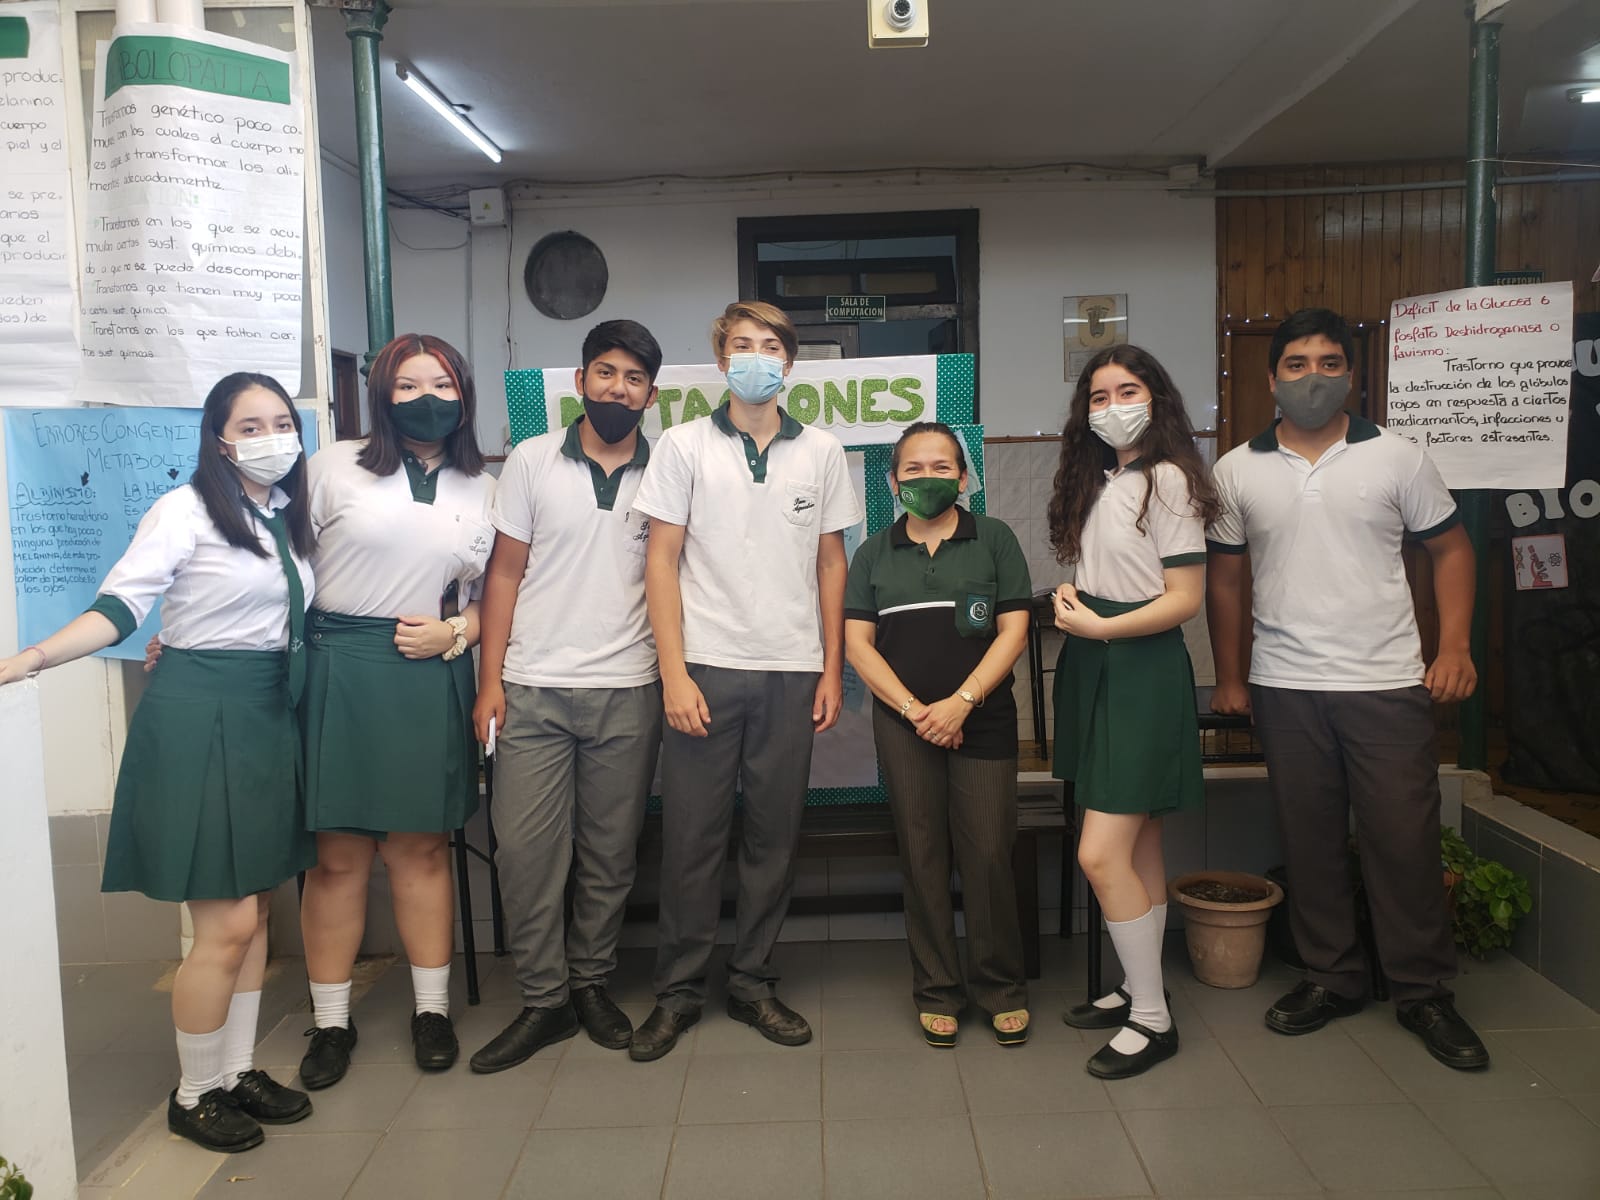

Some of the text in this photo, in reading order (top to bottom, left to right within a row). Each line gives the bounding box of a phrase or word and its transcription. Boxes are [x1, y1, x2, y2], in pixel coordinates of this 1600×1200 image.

[151, 103, 224, 124] genético
[234, 117, 272, 134] poco
[0, 121, 47, 134] cuerpo
[6, 139, 62, 153] piel y el
[155, 127, 200, 141] cuales
[210, 132, 222, 145] el
[231, 139, 283, 155] cuerpo
[133, 147, 229, 168] transformar
[240, 158, 264, 173] los
[8, 190, 24, 200] se
[146, 217, 163, 227] en
[171, 216, 193, 230] los
[207, 223, 235, 239] que
[243, 225, 260, 234] se
[1, 229, 50, 247] que el
[153, 262, 194, 275] puede
[146, 283, 167, 297] que
[176, 281, 222, 297] tienen
[232, 289, 262, 302] muy
[841, 297, 870, 307] SALA DE
[1445, 299, 1461, 312] de
[1466, 299, 1478, 311] la
[1480, 296, 1532, 309] Glucosa
[1540, 295, 1551, 305] 6
[30, 311, 47, 323] de
[828, 307, 883, 317] COMPUTACION
[144, 326, 159, 336] en
[166, 324, 185, 336] los
[196, 329, 218, 342] que
[224, 326, 262, 338] faltan
[1394, 326, 1438, 343] fosfato
[1444, 323, 1543, 339] Deshidrogenasa
[1443, 357, 1505, 373] Trastorno
[1510, 360, 1534, 376] que
[1389, 375, 1569, 394] la destrucción de los glóbulos
[1390, 391, 1567, 412] rojos en respuesta a ciertos
[1387, 411, 1564, 427] medicamentos, infecciones u
[1426, 431, 1473, 447] factores
[123, 482, 141, 497] LA
[11, 526, 26, 535] en
[30, 524, 46, 535] los
[14, 539, 53, 551] ninguna
[23, 583, 41, 594] los
[43, 585, 65, 597] ojos
